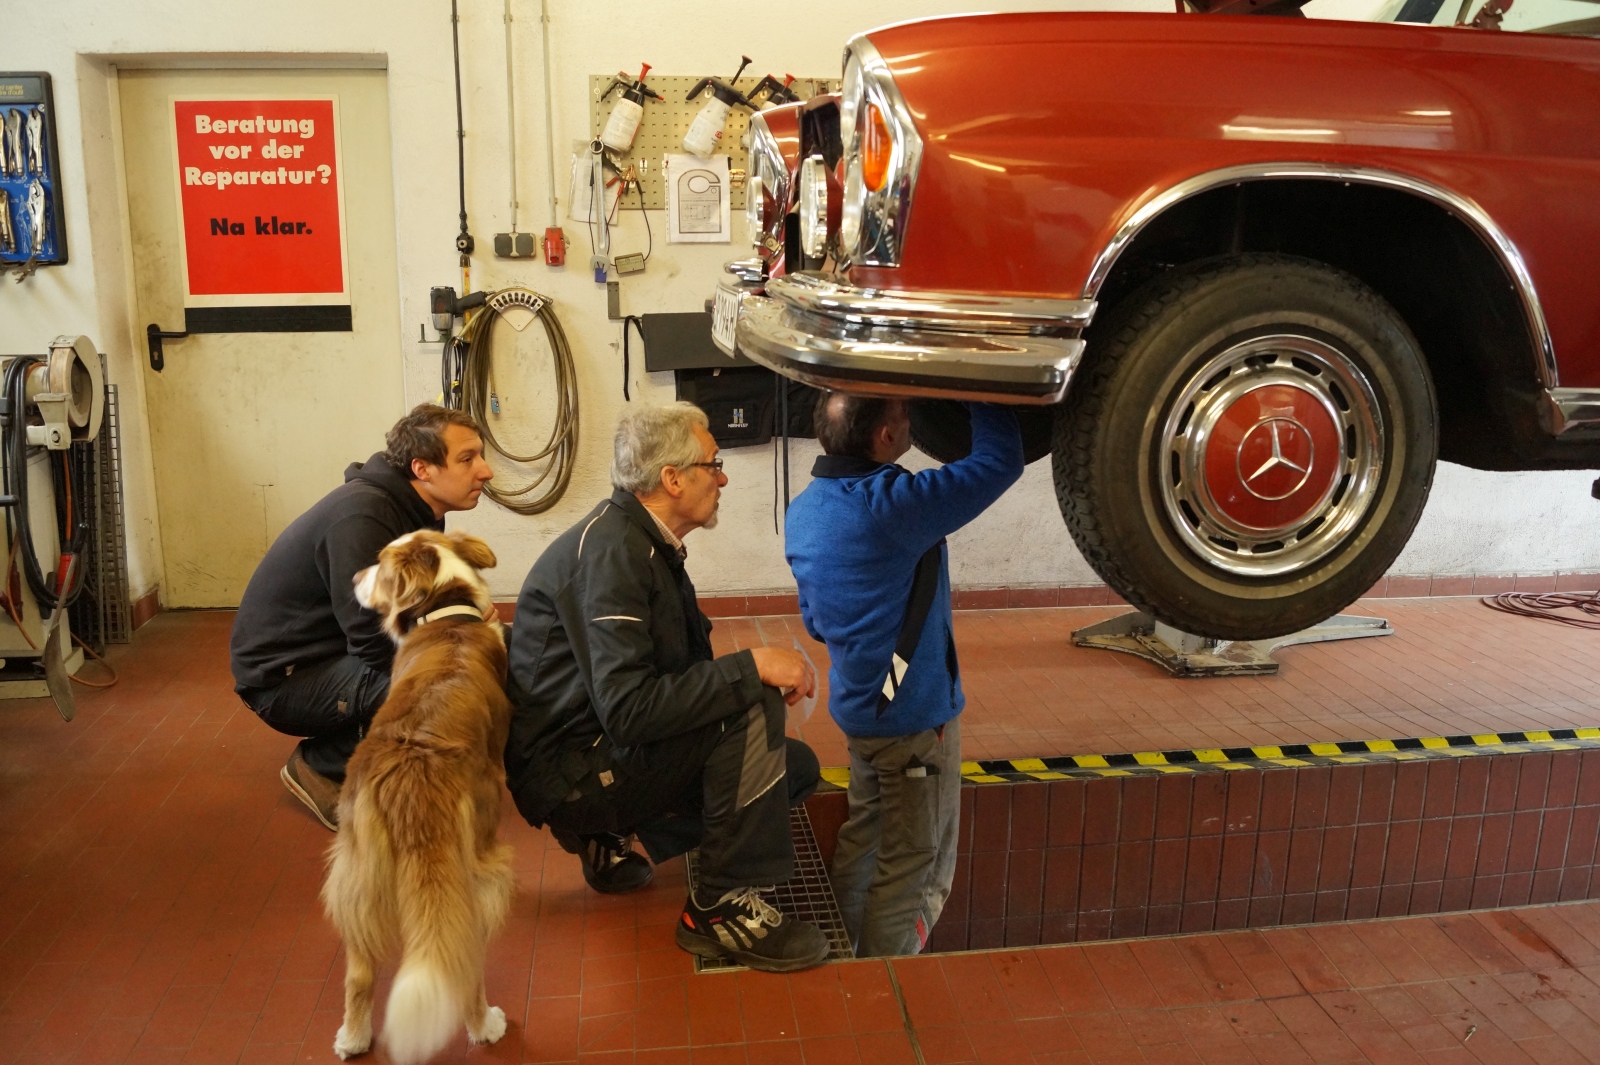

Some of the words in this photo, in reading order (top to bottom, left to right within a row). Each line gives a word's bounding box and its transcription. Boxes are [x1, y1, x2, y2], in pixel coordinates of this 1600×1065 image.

[196, 115, 314, 138] Beratung
[209, 146, 252, 159] vor
[262, 139, 304, 159] der
[185, 164, 331, 190] Reparatur?
[211, 218, 244, 235] Na
[255, 216, 312, 235] klar.
